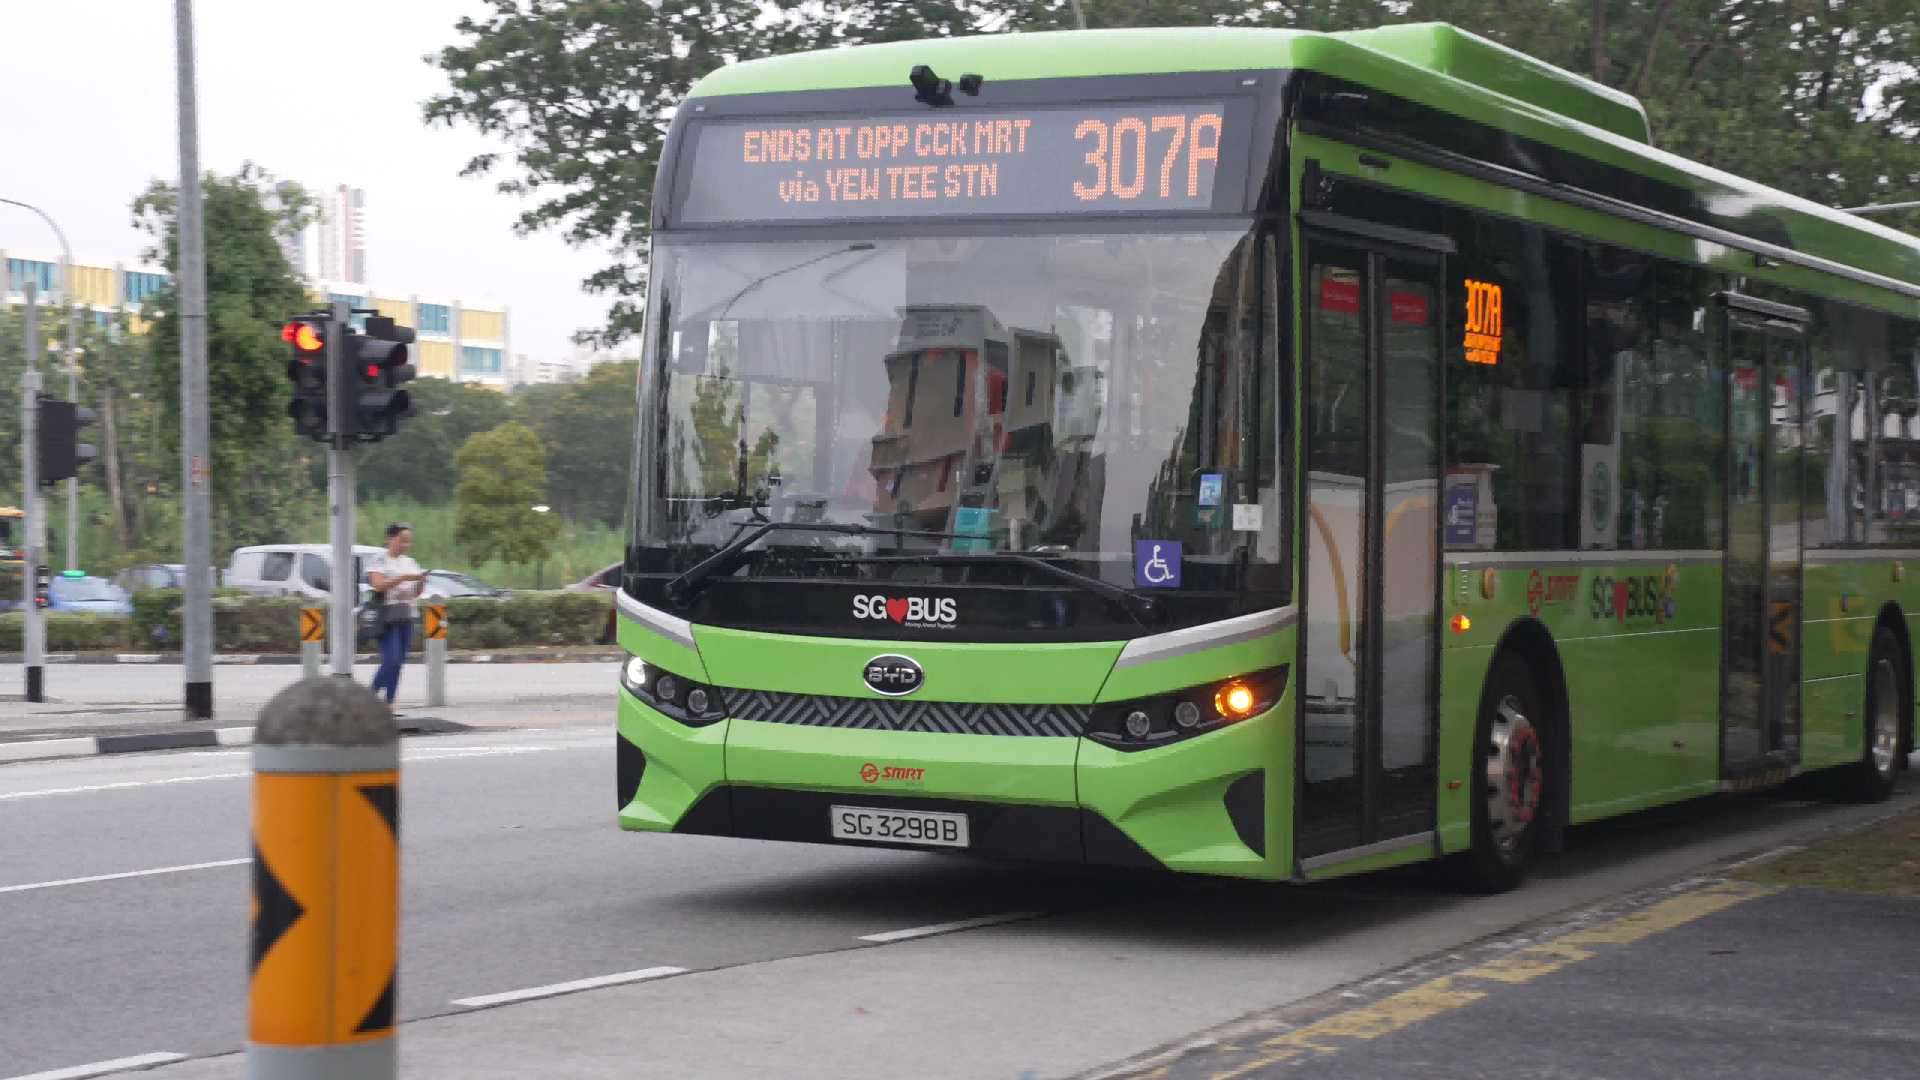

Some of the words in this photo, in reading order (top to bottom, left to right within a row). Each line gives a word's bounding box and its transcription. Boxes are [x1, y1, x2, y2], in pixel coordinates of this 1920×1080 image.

[743, 129, 811, 162] ENDS
[817, 127, 852, 160] AT
[857, 124, 908, 159] OPP
[914, 122, 968, 157] CCK
[975, 119, 1031, 154] MRT
[1073, 113, 1223, 200] 307A
[779, 171, 819, 203] via
[826, 167, 880, 200] YEW
[886, 165, 937, 198] TEE
[944, 163, 998, 197] STN
[868, 666, 917, 683] BYD
[881, 766, 926, 781] SMRT
